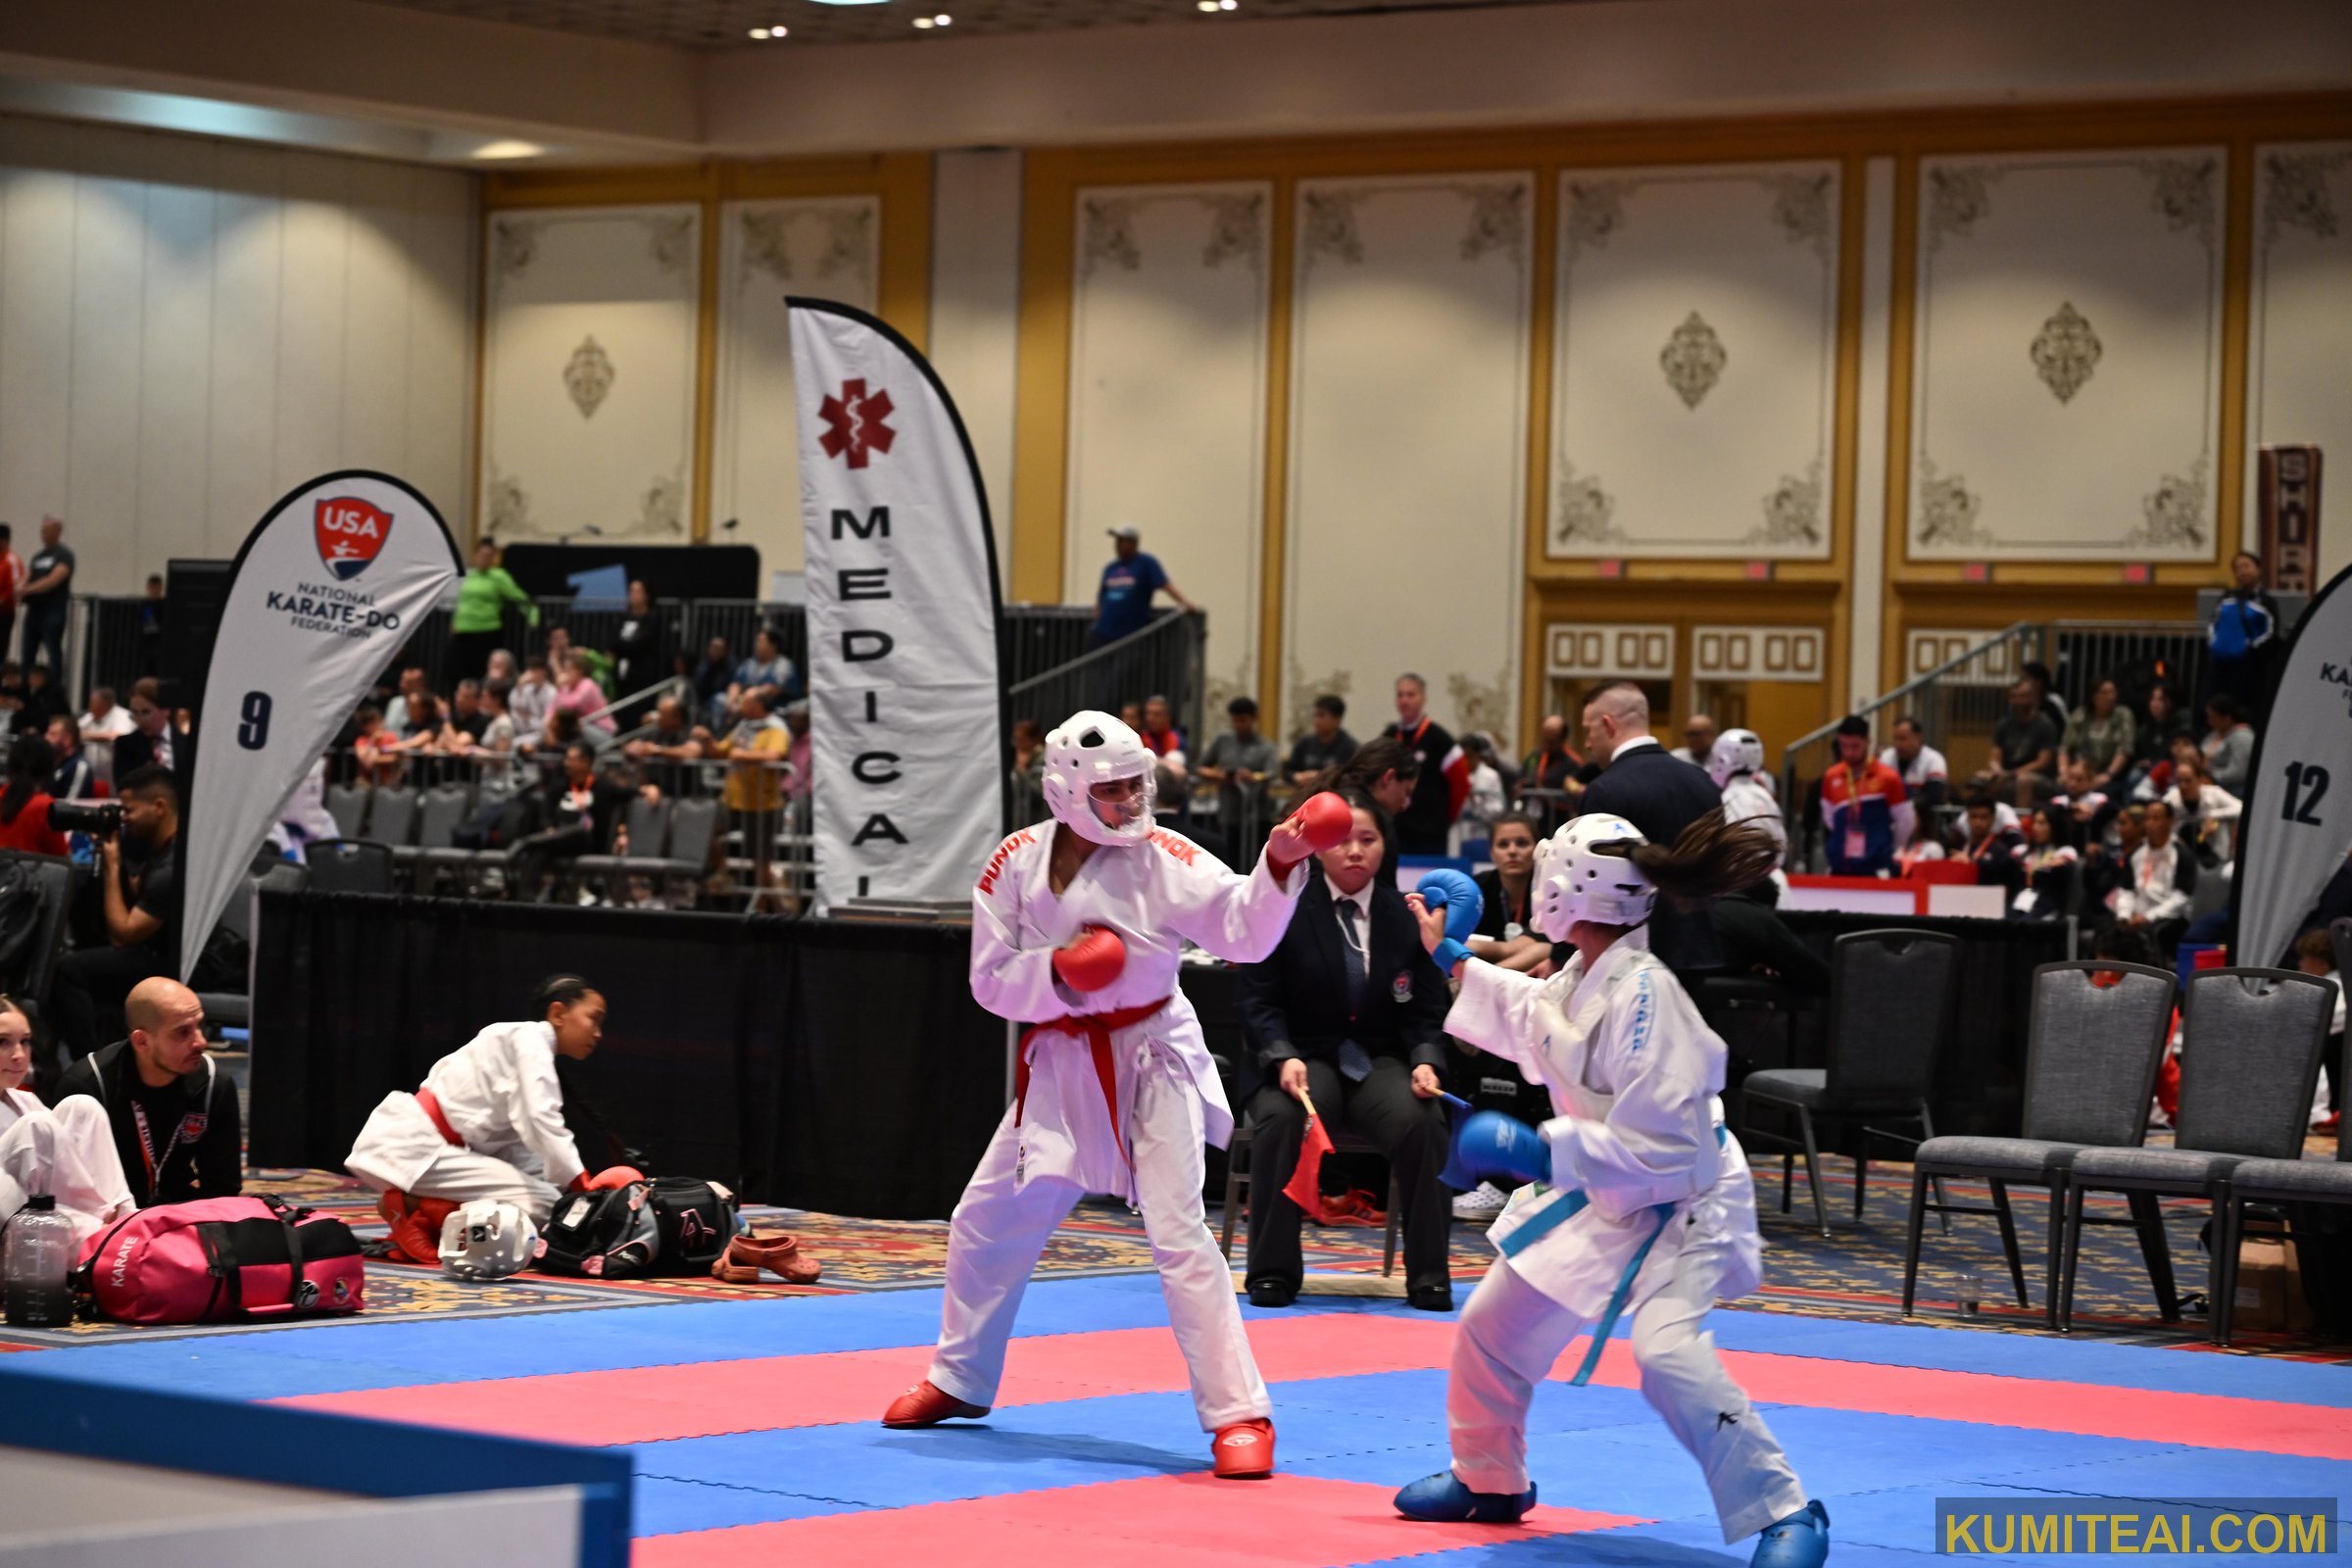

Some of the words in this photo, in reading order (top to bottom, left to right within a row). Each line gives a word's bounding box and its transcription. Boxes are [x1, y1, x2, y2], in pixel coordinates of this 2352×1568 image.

[323, 506, 379, 539] USA
[267, 590, 401, 631] KARATE-DO
[297, 581, 376, 608] NATIONAL
[290, 615, 372, 639] FEDERATION
[2320, 662, 2352, 688] KA
[237, 690, 272, 752] 9
[2281, 760, 2330, 827] 12
[978, 828, 1036, 896] PUNOK
[1146, 829, 1201, 867] NOK
[110, 1236, 139, 1288] KARATE
